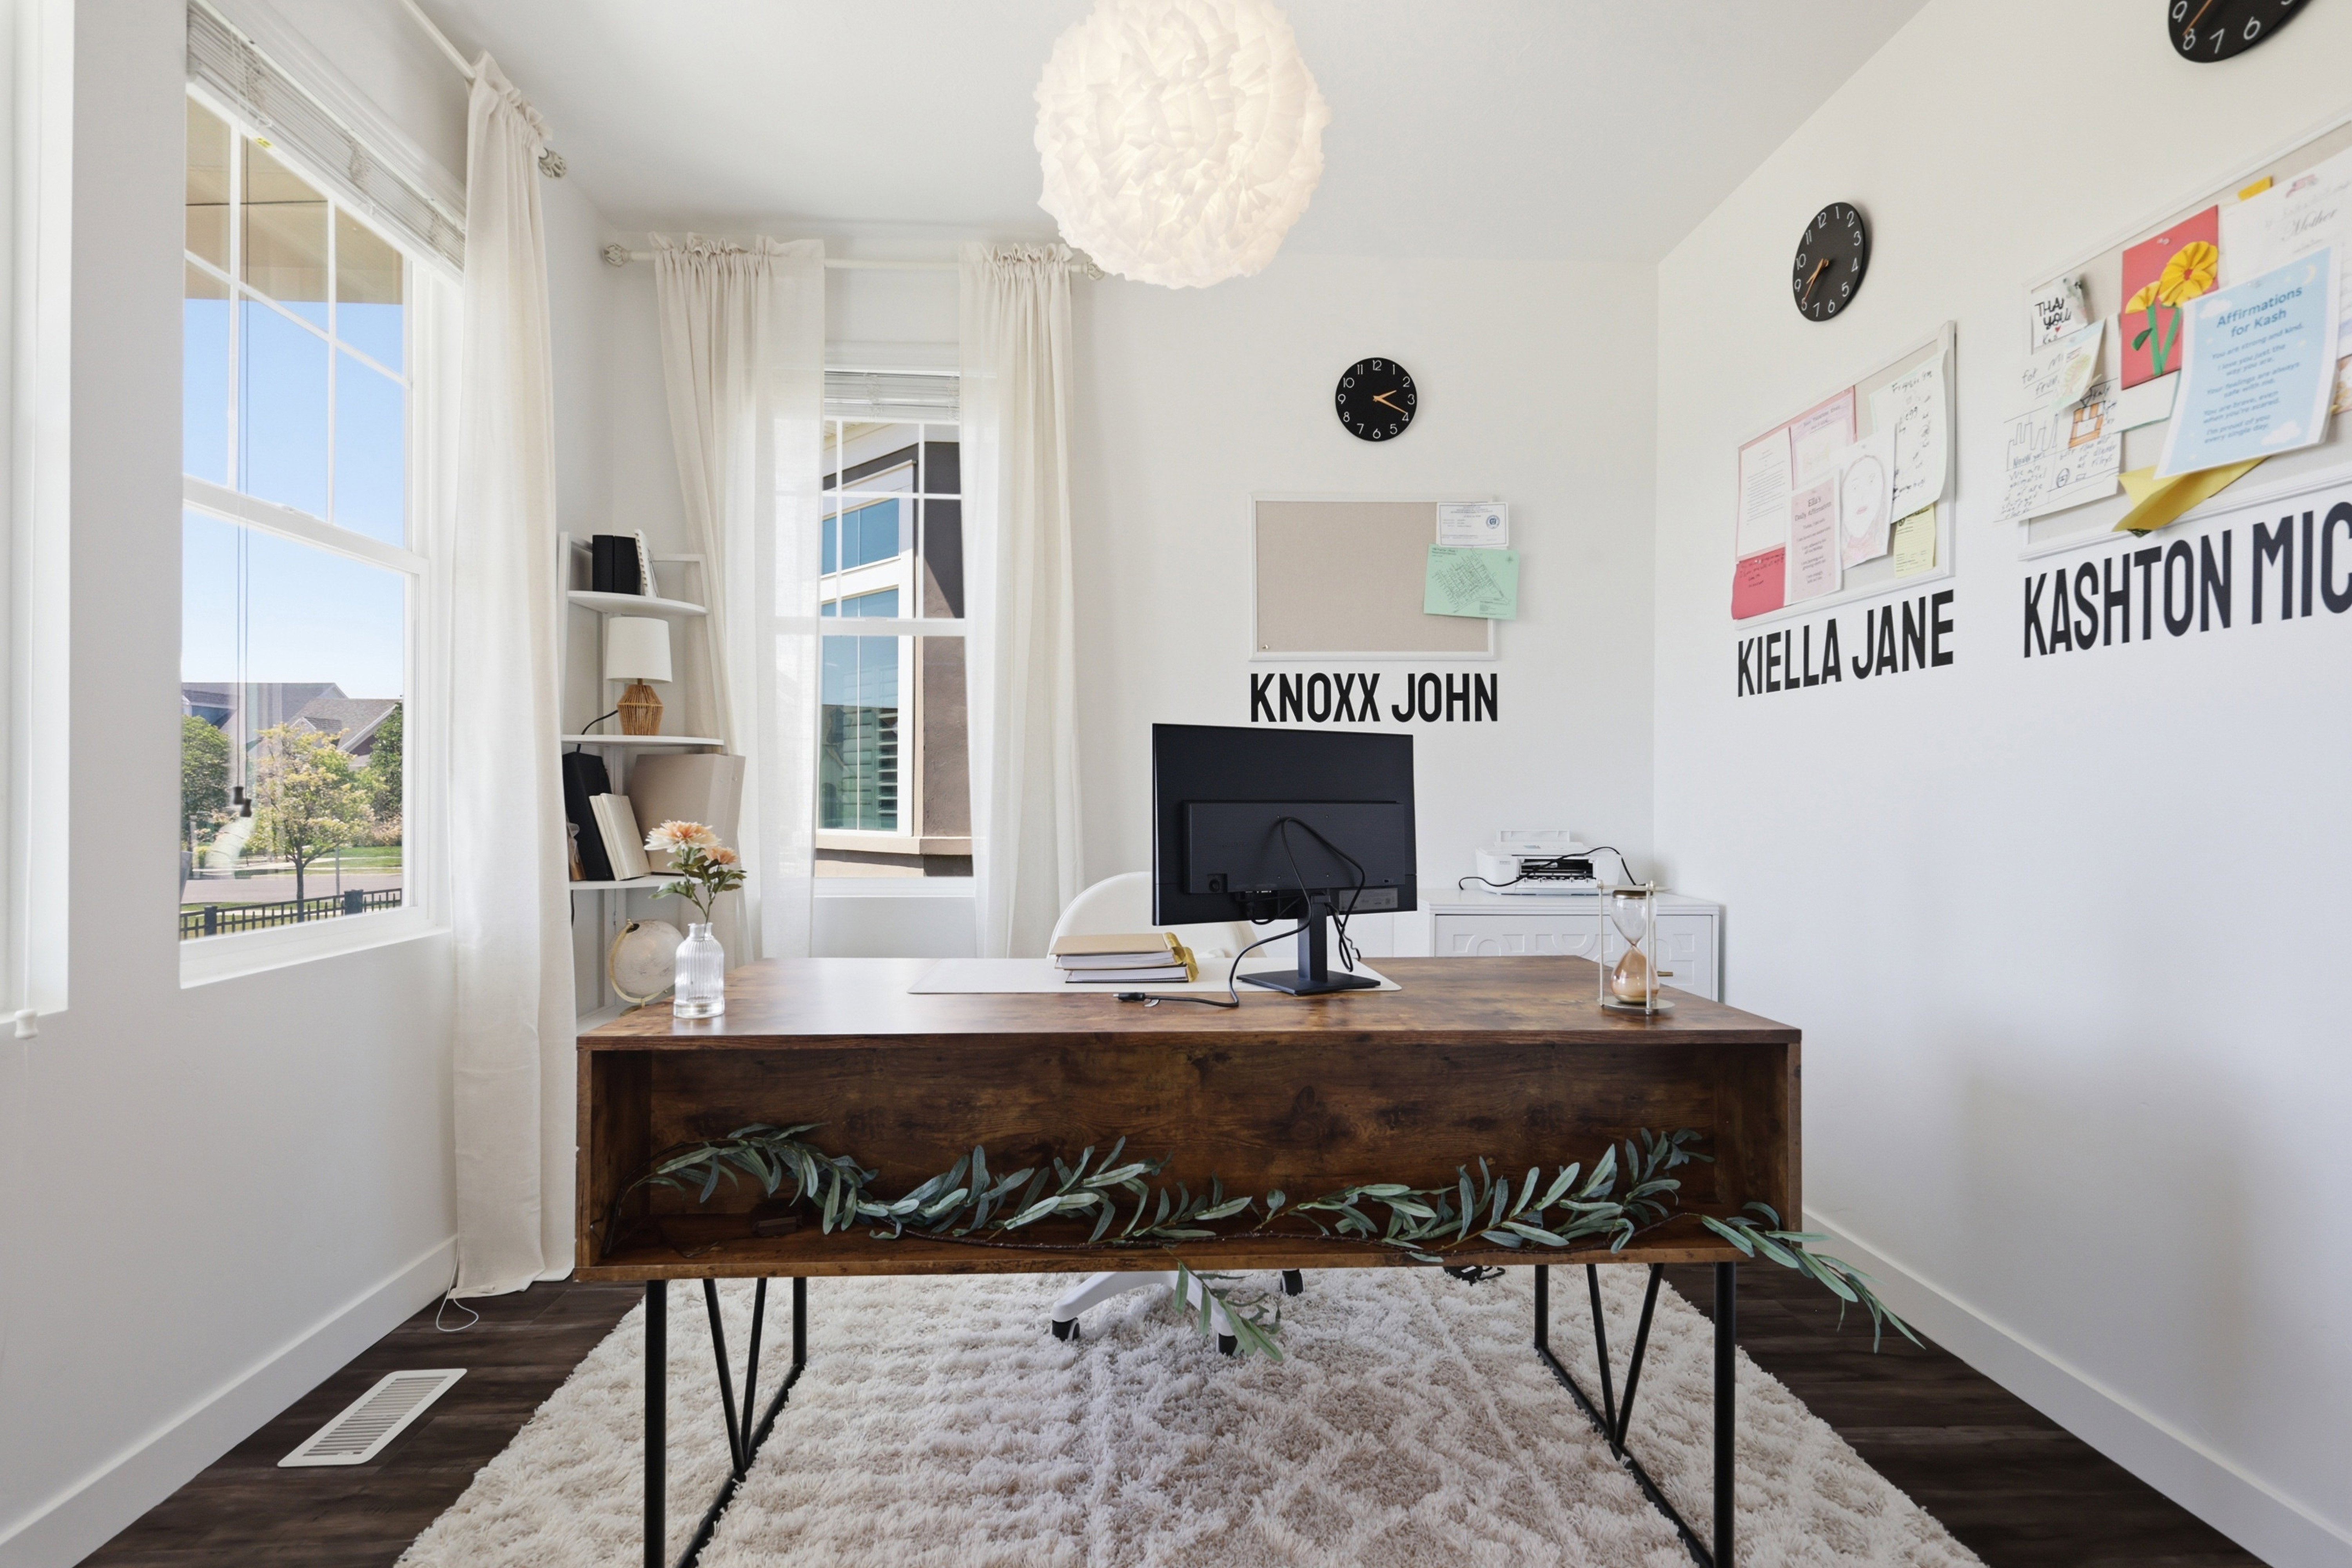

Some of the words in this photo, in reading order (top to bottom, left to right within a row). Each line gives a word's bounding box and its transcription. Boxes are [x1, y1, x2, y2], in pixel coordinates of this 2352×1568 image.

[2172, 0, 2188, 23] 9
[2243, 16, 2261, 41] 6
[2183, 28, 2196, 51] 8
[2209, 28, 2225, 54] 7
[1817, 212, 1827, 229] 12
[1835, 206, 1839, 220] 1
[1847, 211, 1855, 227] 2
[1806, 229, 1812, 245] 11
[1853, 230, 1861, 246] 3
[1796, 253, 1806, 270] 10
[1851, 257, 1858, 272] 4
[1794, 278, 1802, 292] 9
[1841, 281, 1849, 297] 5
[1812, 302, 1820, 317] 7
[1828, 299, 1835, 314] 6
[2217, 287, 2302, 328] Affirmations
[2231, 323, 2250, 337] for
[2254, 309, 2287, 328] Kash
[2241, 337, 2267, 349] strong
[2269, 330, 2283, 340] and
[2239, 356, 2253, 364] you
[2254, 349, 2270, 360] just
[2272, 344, 2285, 352] the
[1357, 364, 1363, 375] 11
[1372, 360, 1382, 371] 12
[1392, 364, 1396, 375] 1
[2243, 363, 2257, 372] you
[1343, 377, 1355, 388] 10
[1403, 376, 1410, 387] 2
[1338, 394, 1346, 405] 9
[1407, 394, 1415, 405] 3
[1343, 412, 1350, 422] 8
[1402, 412, 1409, 422] 4
[1357, 423, 1364, 434] 7
[1373, 428, 1381, 439] 6
[1390, 424, 1397, 435] 5
[2024, 529, 2232, 658] KASHTON
[1739, 618, 1841, 697] KIELLA
[1853, 590, 1953, 679] JANE
[1251, 673, 1380, 722] KNOXX
[1392, 673, 1497, 722] JOHN
